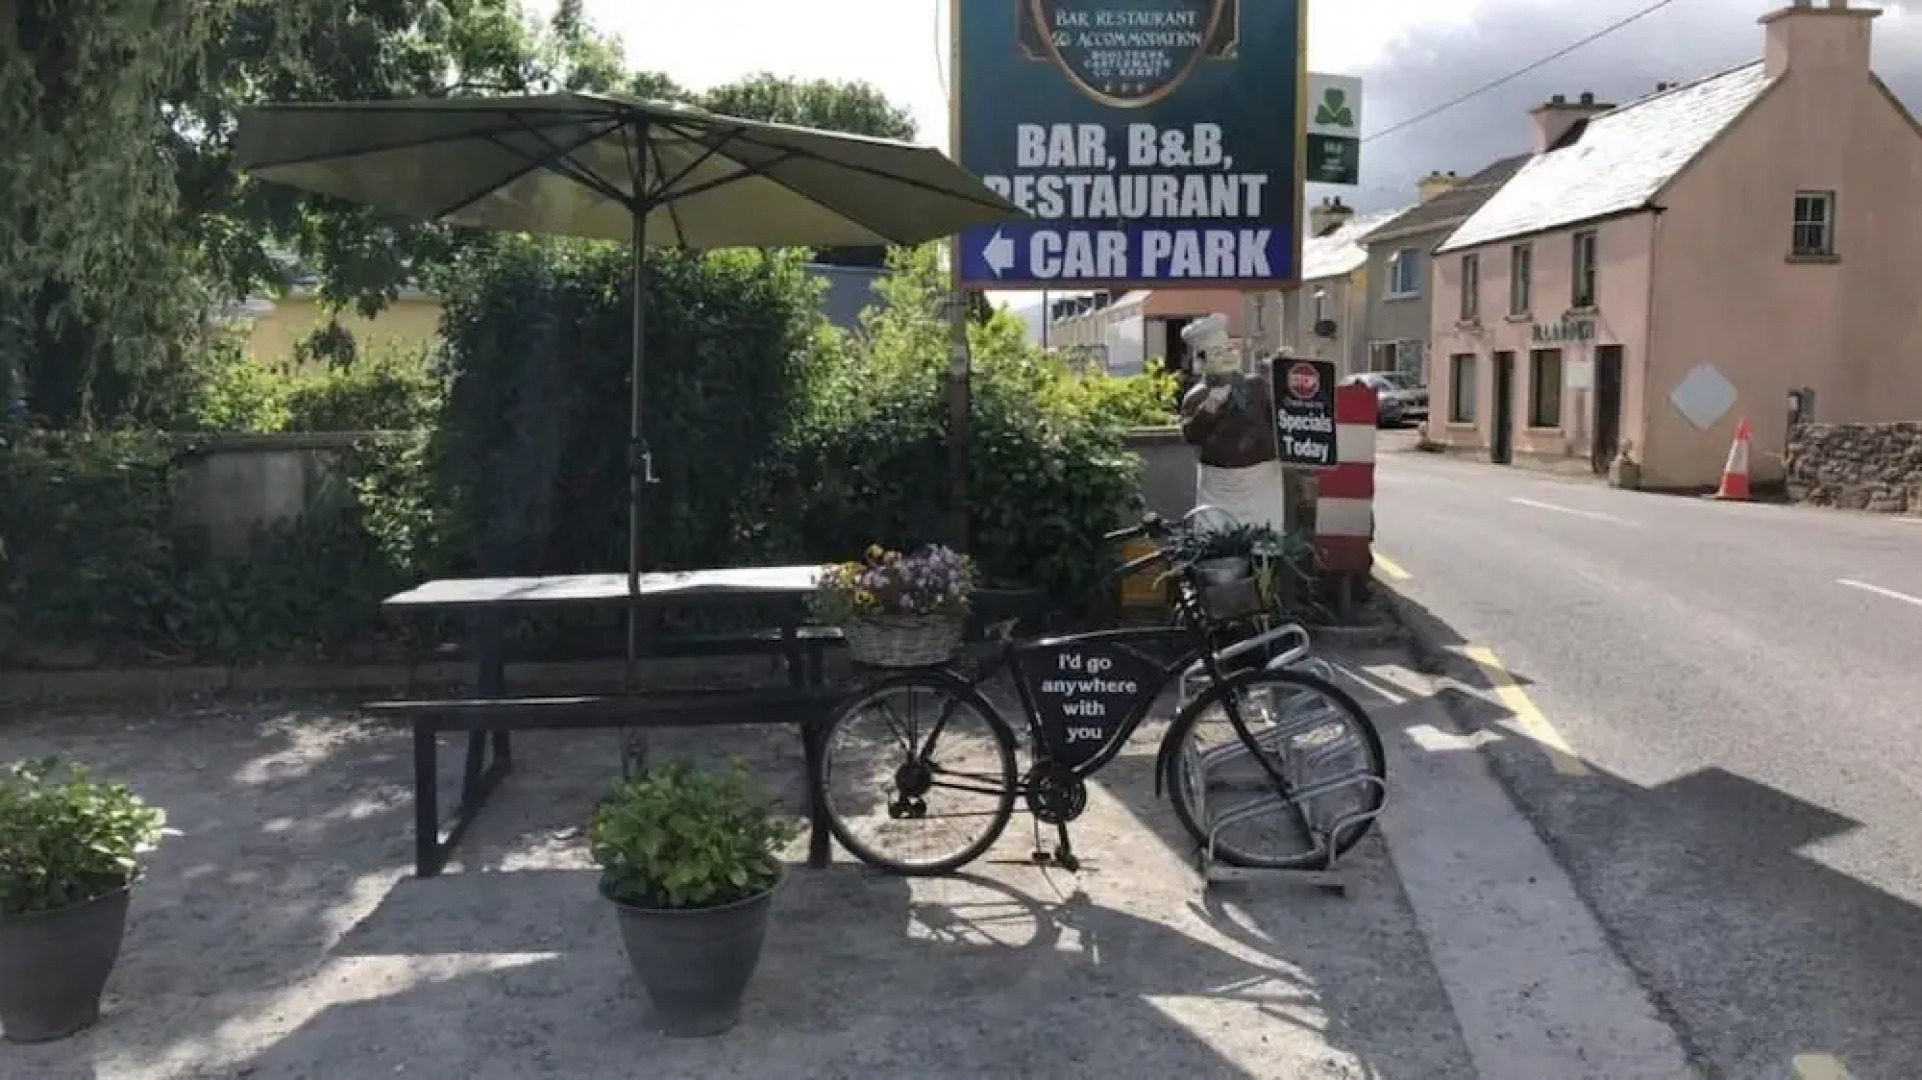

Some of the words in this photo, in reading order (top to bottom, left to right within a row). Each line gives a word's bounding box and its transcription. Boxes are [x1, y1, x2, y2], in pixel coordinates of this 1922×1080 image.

[1056, 10, 1089, 26] BAR
[1097, 10, 1196, 26] RESTAURANT
[1076, 32, 1201, 47] ACCOMMODATION
[1017, 123, 1117, 170] BAR,
[1128, 123, 1233, 170] B&B,
[1029, 229, 1128, 278] CAR
[1141, 229, 1272, 278] PARK
[1277, 408, 1333, 433] Specials
[1283, 435, 1329, 463] Today
[1059, 652, 1081, 669] I'd
[1087, 657, 1112, 673] go
[1041, 678, 1137, 697] anywhere
[1062, 699, 1105, 716] with
[1066, 727, 1102, 743] you
